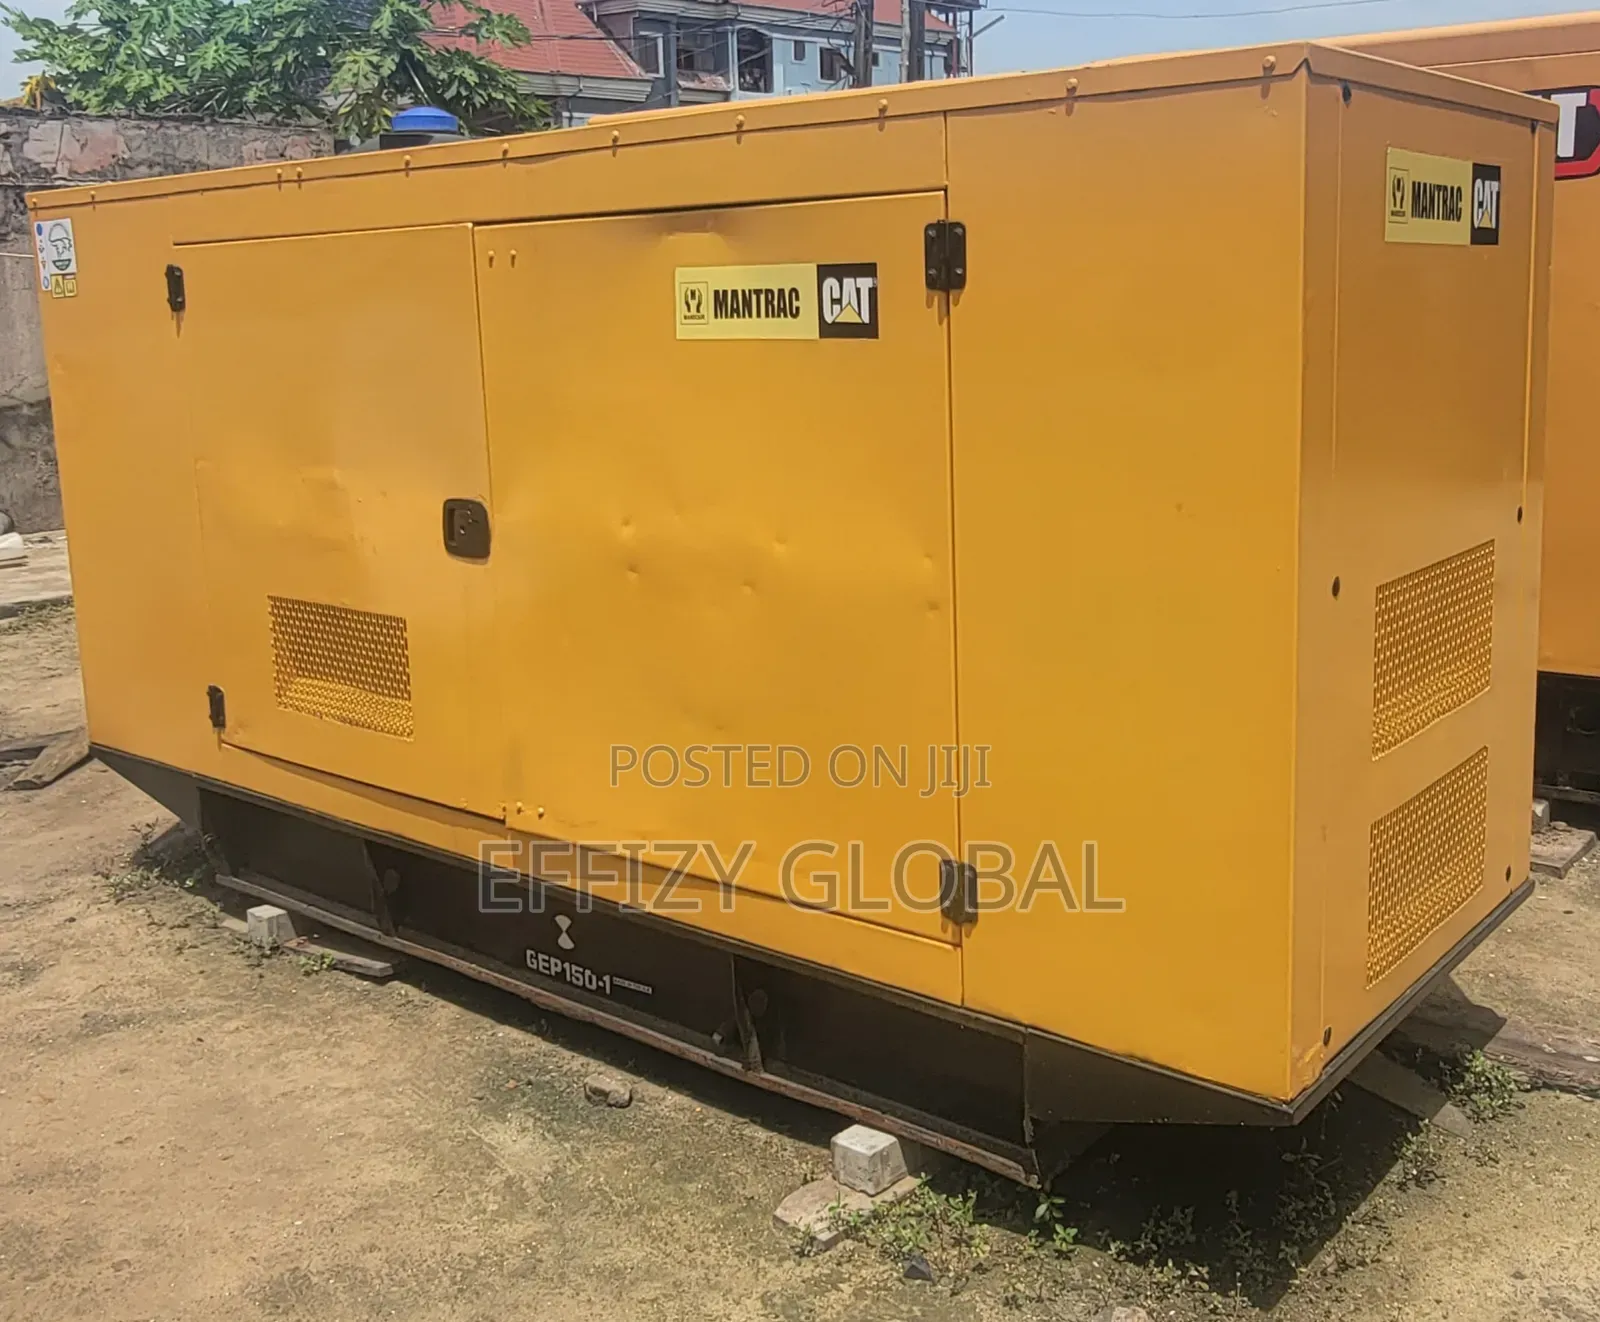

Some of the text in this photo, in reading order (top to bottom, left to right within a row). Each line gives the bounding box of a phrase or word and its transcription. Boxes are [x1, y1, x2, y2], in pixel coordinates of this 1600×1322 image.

[1411, 178, 1500, 229] MANTRAC CAT
[713, 277, 874, 324] MANTRAC CAT
[526, 949, 611, 994] GEP150-1
